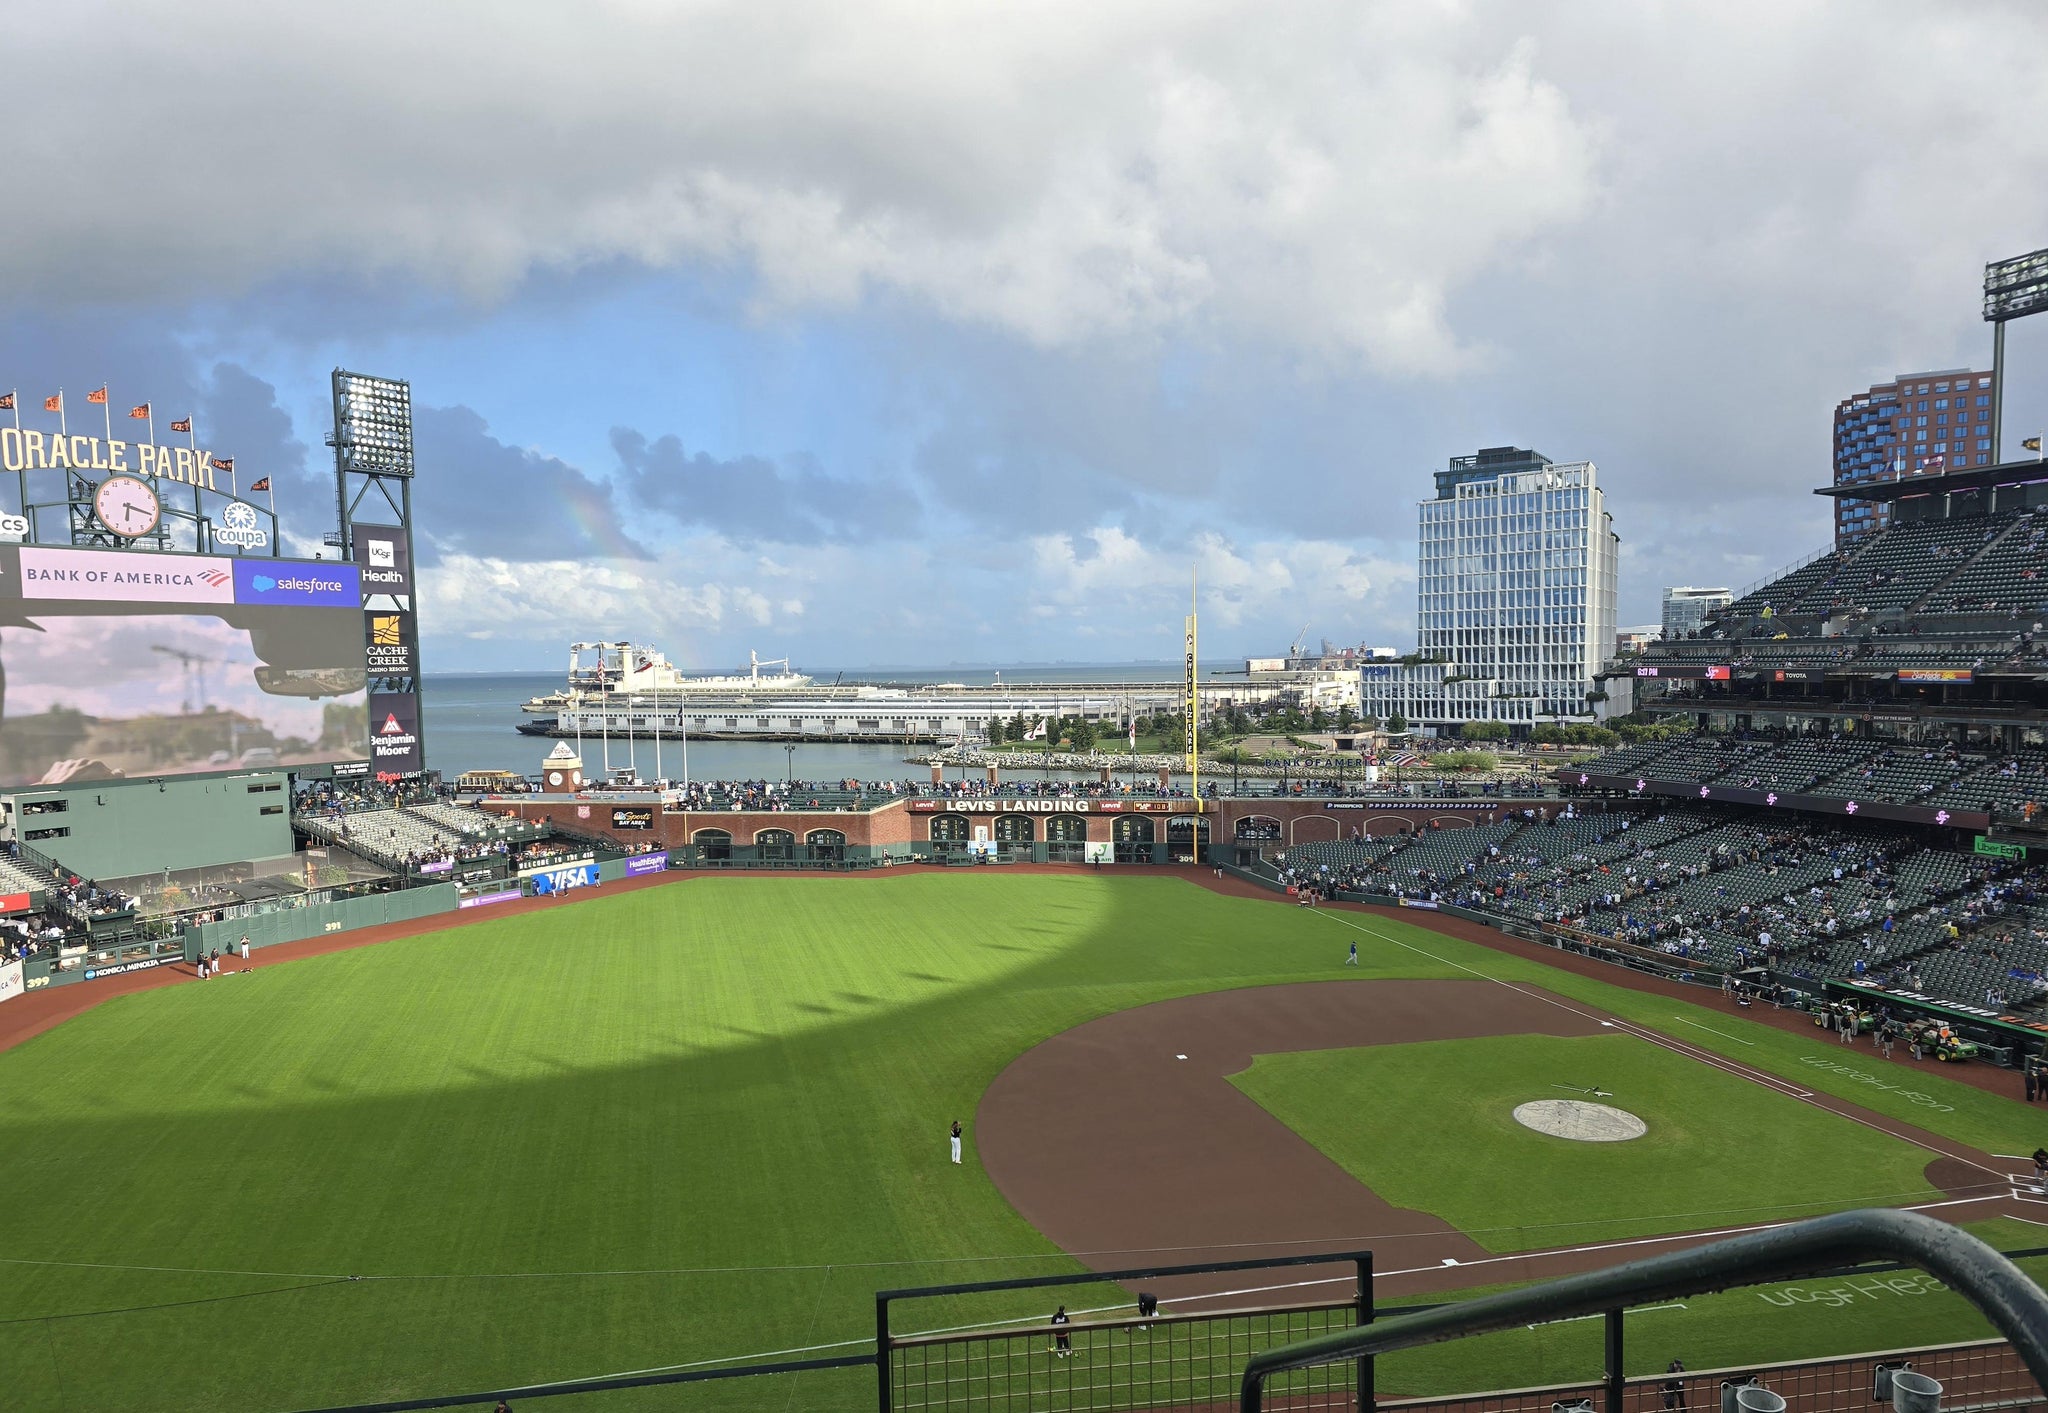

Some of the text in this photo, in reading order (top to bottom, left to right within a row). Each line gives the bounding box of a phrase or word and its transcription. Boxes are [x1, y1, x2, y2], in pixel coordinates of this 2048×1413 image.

[1, 427, 216, 490] ORACLE PARK
[219, 530, 263, 546] coupa
[371, 548, 391, 559] UCSF
[27, 568, 194, 586] BANK OF AMERICA
[362, 570, 403, 583] Health
[278, 577, 342, 593] salesforce
[366, 646, 408, 655] CACHE
[368, 656, 407, 665] CREEK
[1649, 667, 1658, 676] PM
[1265, 758, 1386, 767] BANK OF AMERICA
[401, 771, 421, 779] LIGHT
[1002, 801, 1089, 811] LANDING
[1977, 842, 1998, 852] Uber
[519, 860, 549, 869] WELCOME
[544, 867, 588, 889] VISA
[325, 922, 341, 931] 391
[96, 965, 126, 977] KONICA
[127, 959, 159, 972] MINOLTA
[27, 976, 50, 988] 399
[1758, 1275, 1950, 1307] UCSF Hea
